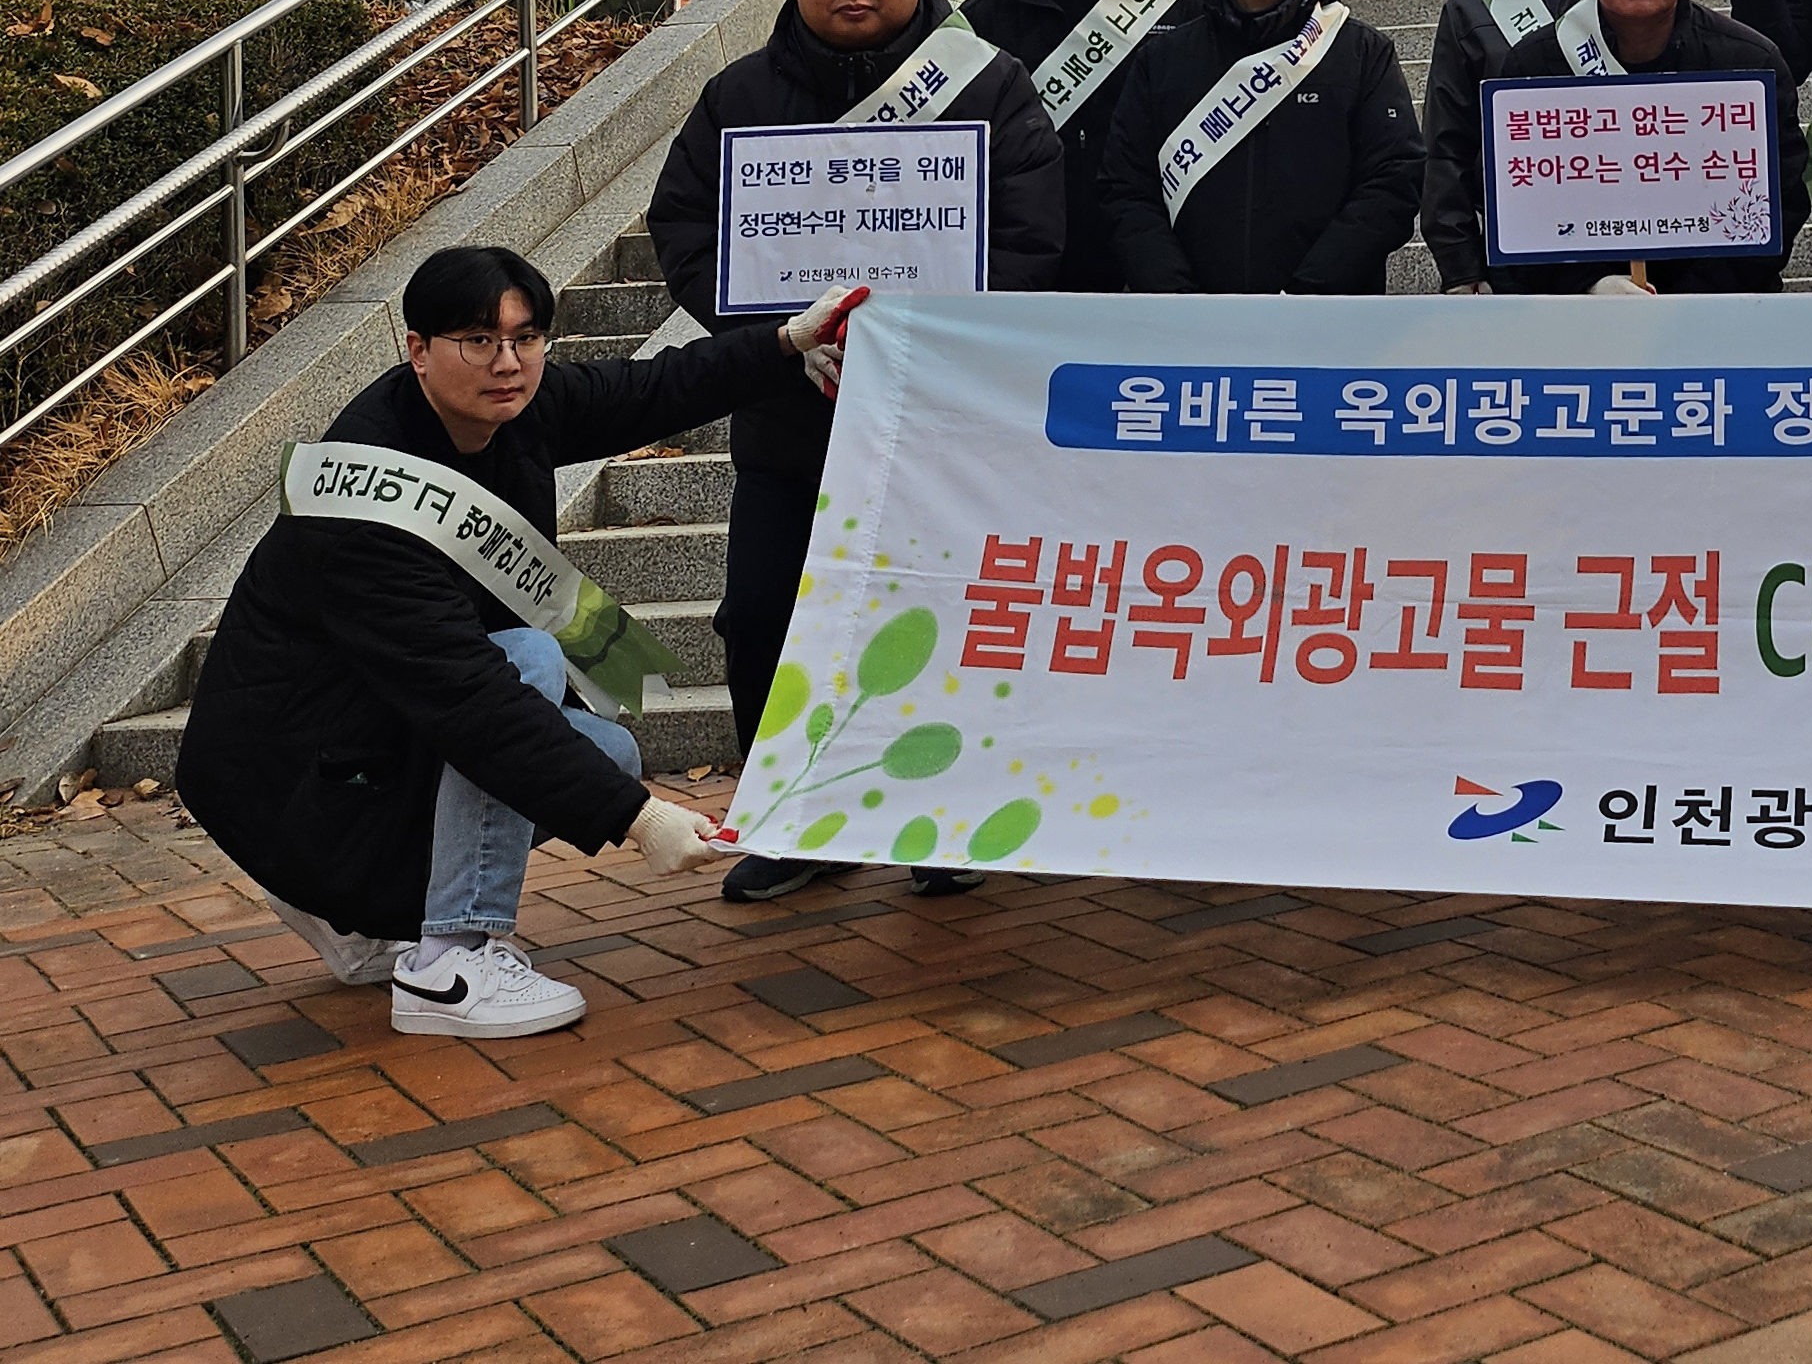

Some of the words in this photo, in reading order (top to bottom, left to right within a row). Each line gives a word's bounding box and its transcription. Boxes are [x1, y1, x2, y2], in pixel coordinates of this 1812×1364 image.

[1038, 30, 1114, 111] 행복한
[1199, 62, 1283, 144] 광고물
[1297, 93, 1320, 104] K2
[1506, 107, 1621, 141] 불법광고
[1631, 105, 1689, 137] 없는
[1700, 101, 1756, 132] 거리
[740, 160, 813, 188] 안전한
[826, 157, 902, 184] 통학을
[916, 156, 966, 182] 위해
[1507, 154, 1623, 187] 찾아오는
[1633, 151, 1691, 183] 연수
[1701, 148, 1758, 180] 손님
[738, 209, 846, 238] 정당현수막
[855, 206, 967, 233] 자제합시다
[1585, 219, 1651, 236] 인천광역시
[1656, 216, 1710, 234] 연수구청
[798, 267, 860, 283] 인천광역시
[867, 265, 918, 281] 연수구청
[1110, 375, 1304, 443] 올바른
[1334, 377, 1733, 447] 옥외광고문화
[313, 456, 456, 524] 안전하고
[455, 504, 528, 576] 행복한
[515, 556, 558, 606] 연수
[959, 533, 1536, 691] 불법옥외광고물
[1562, 549, 1721, 694] 근절
